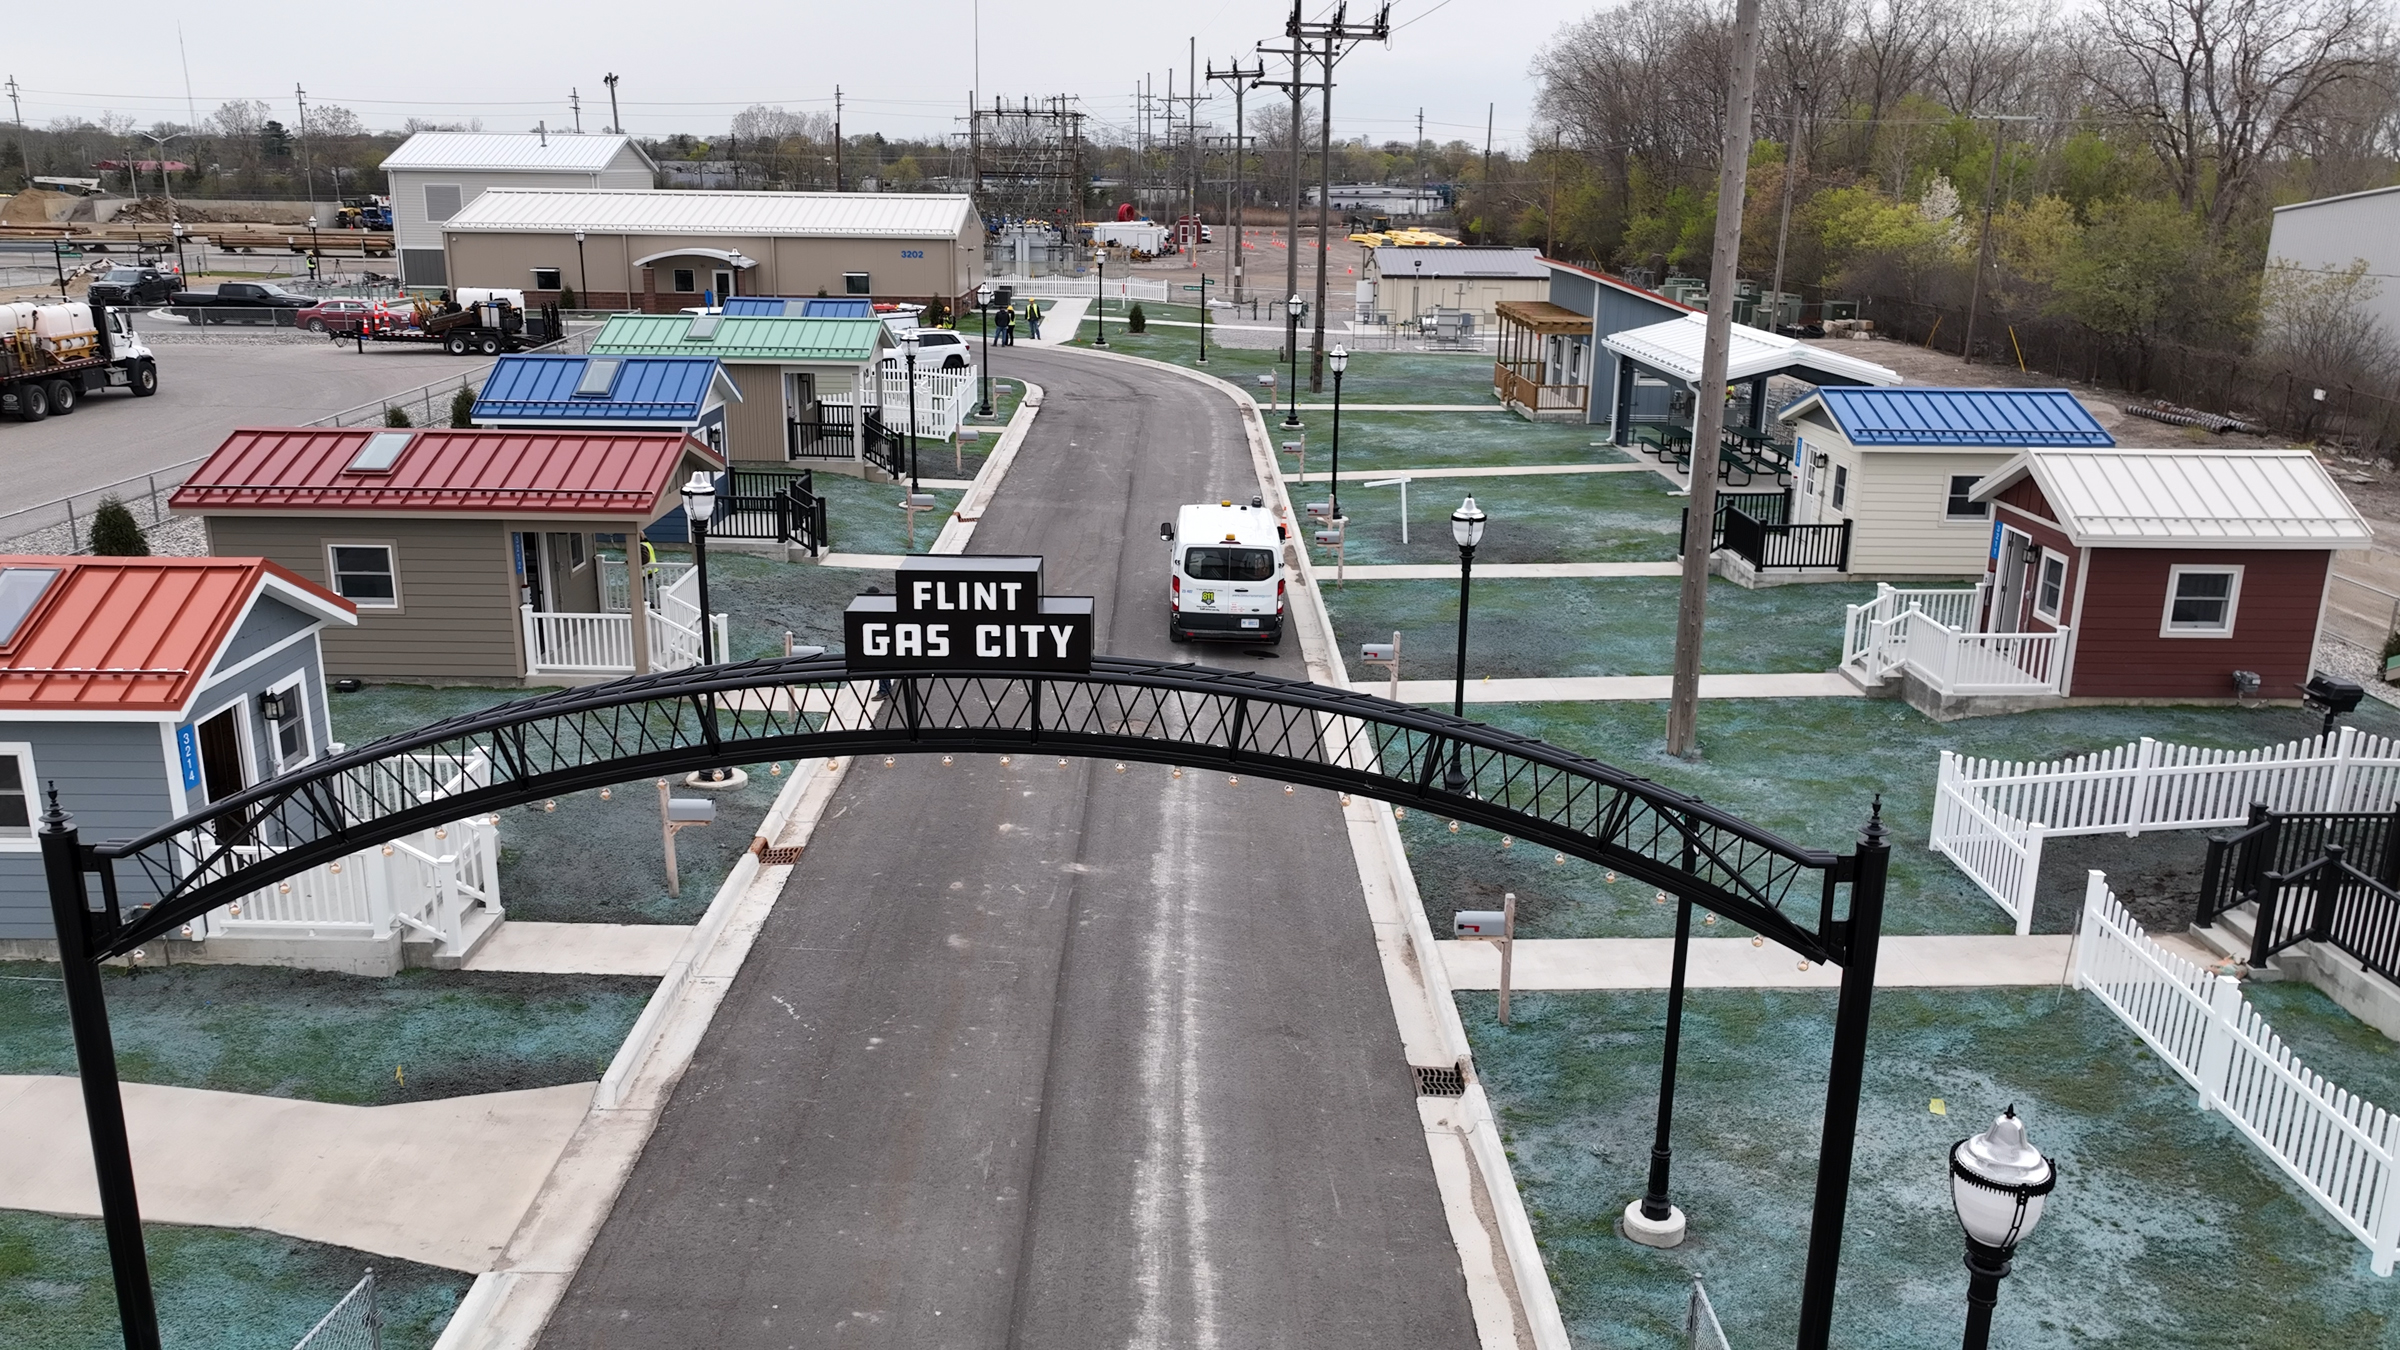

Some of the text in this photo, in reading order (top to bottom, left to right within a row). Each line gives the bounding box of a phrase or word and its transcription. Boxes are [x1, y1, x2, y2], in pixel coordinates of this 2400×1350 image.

[901, 250, 924, 259] 3202
[1993, 524, 2001, 555] 3211
[912, 580, 1022, 611] FLINT
[1202, 591, 1214, 601] 811
[862, 623, 1075, 658] GAS CITY
[183, 732, 195, 781] 3214
